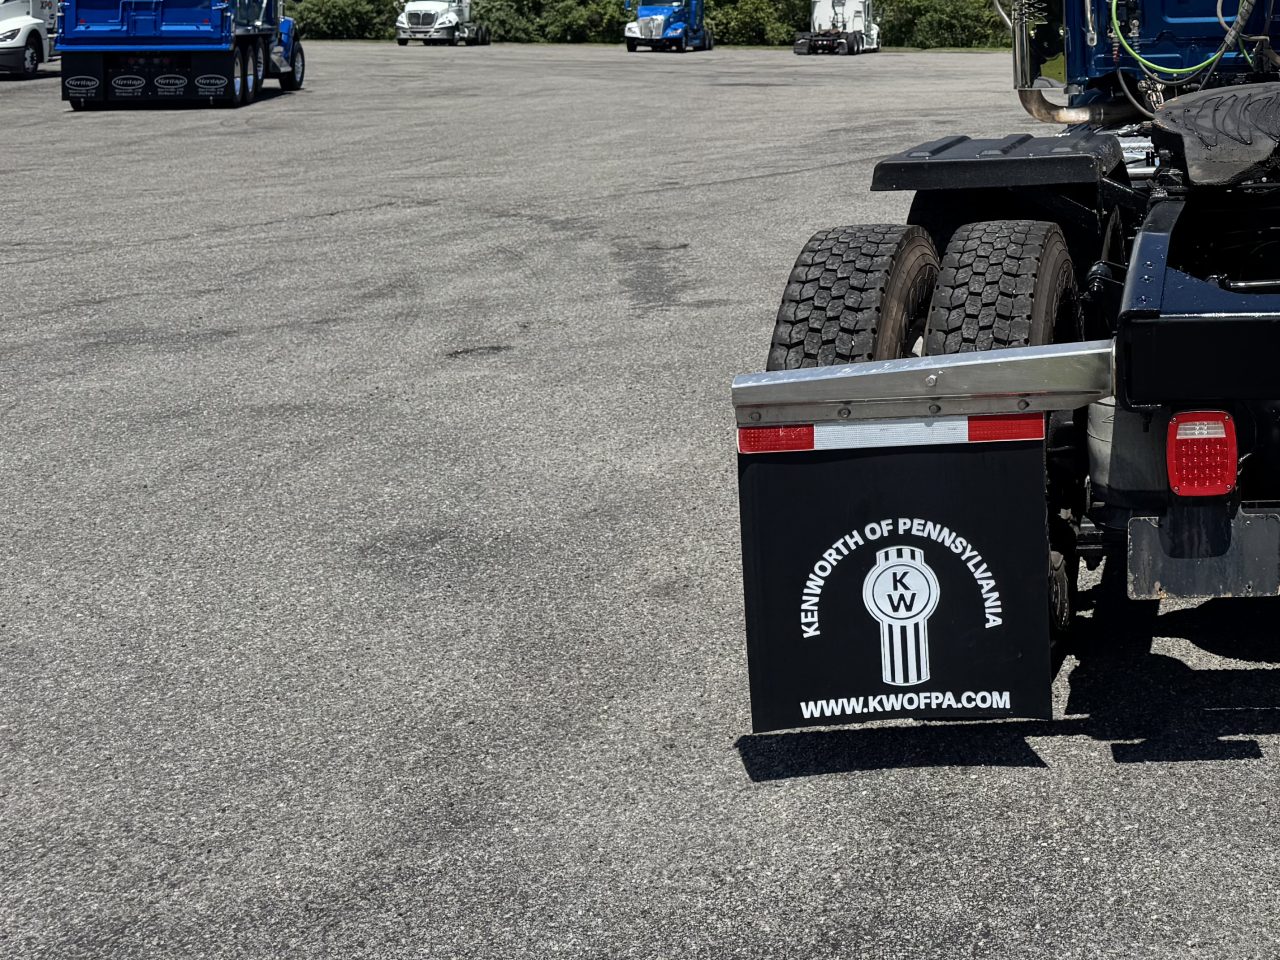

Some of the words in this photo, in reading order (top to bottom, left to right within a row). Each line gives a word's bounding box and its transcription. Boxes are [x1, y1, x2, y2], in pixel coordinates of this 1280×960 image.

[800, 530, 864, 639] KENWORTH
[865, 519, 894, 541] OF
[898, 518, 1003, 629] PENNSYLVANIA
[800, 691, 1011, 719] WWW.KWOFPA.COM
